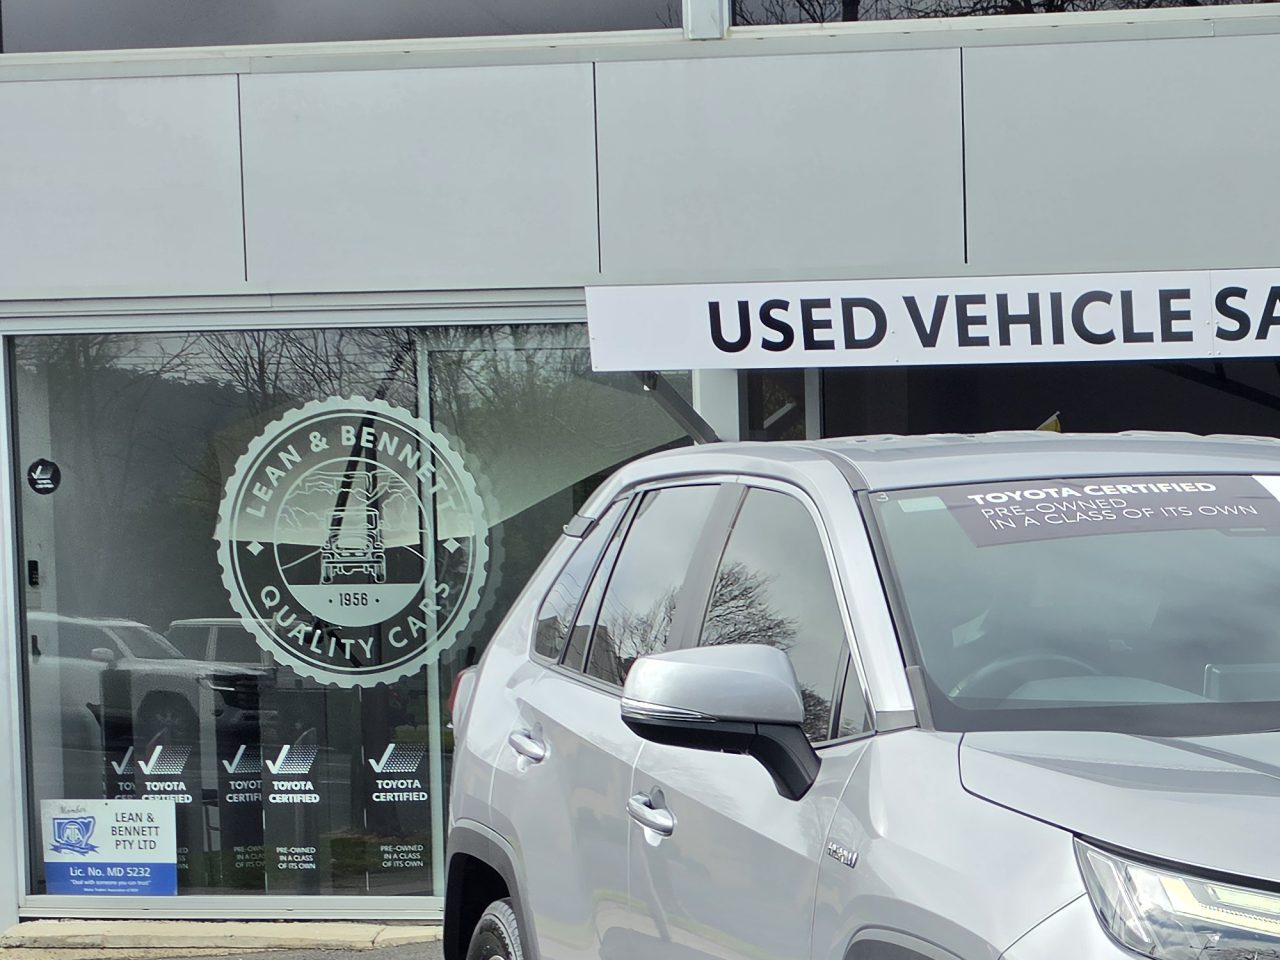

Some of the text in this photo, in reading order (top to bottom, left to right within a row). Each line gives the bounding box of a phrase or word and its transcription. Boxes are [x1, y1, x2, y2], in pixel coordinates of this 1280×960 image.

[708, 296, 888, 353] USED
[902, 288, 1194, 348] VEHICLE
[246, 426, 457, 518] LEAN & BENNETT
[967, 482, 1216, 505] TOYOTA CERTIFIED
[980, 498, 1127, 520] PRE-OWNED
[989, 505, 1258, 530] IN A CLASS OF ITS OWN
[339, 593, 368, 606] 1956
[260, 582, 450, 659] QUALITY CARS
[117, 782, 136, 791] TOY
[145, 782, 186, 791] TOYOTA
[229, 780, 262, 790] TOYOT
[272, 781, 314, 790] TOYOTA
[376, 779, 421, 789] TOYOTA
[226, 794, 262, 803] CERTIFI
[269, 794, 320, 803] CERTIFIED
[372, 792, 428, 802] CERTIFIED
[115, 813, 154, 823] LEAN &
[111, 826, 160, 836] BENNETT
[115, 840, 157, 850] PTY LTD
[380, 844, 424, 852] PRE-OWNED
[399, 852, 421, 860] CLASS
[278, 862, 287, 870] OF
[288, 862, 298, 870] ITS
[405, 860, 424, 868] OWN
[70, 867, 151, 877] Lic. No. MD 5232
